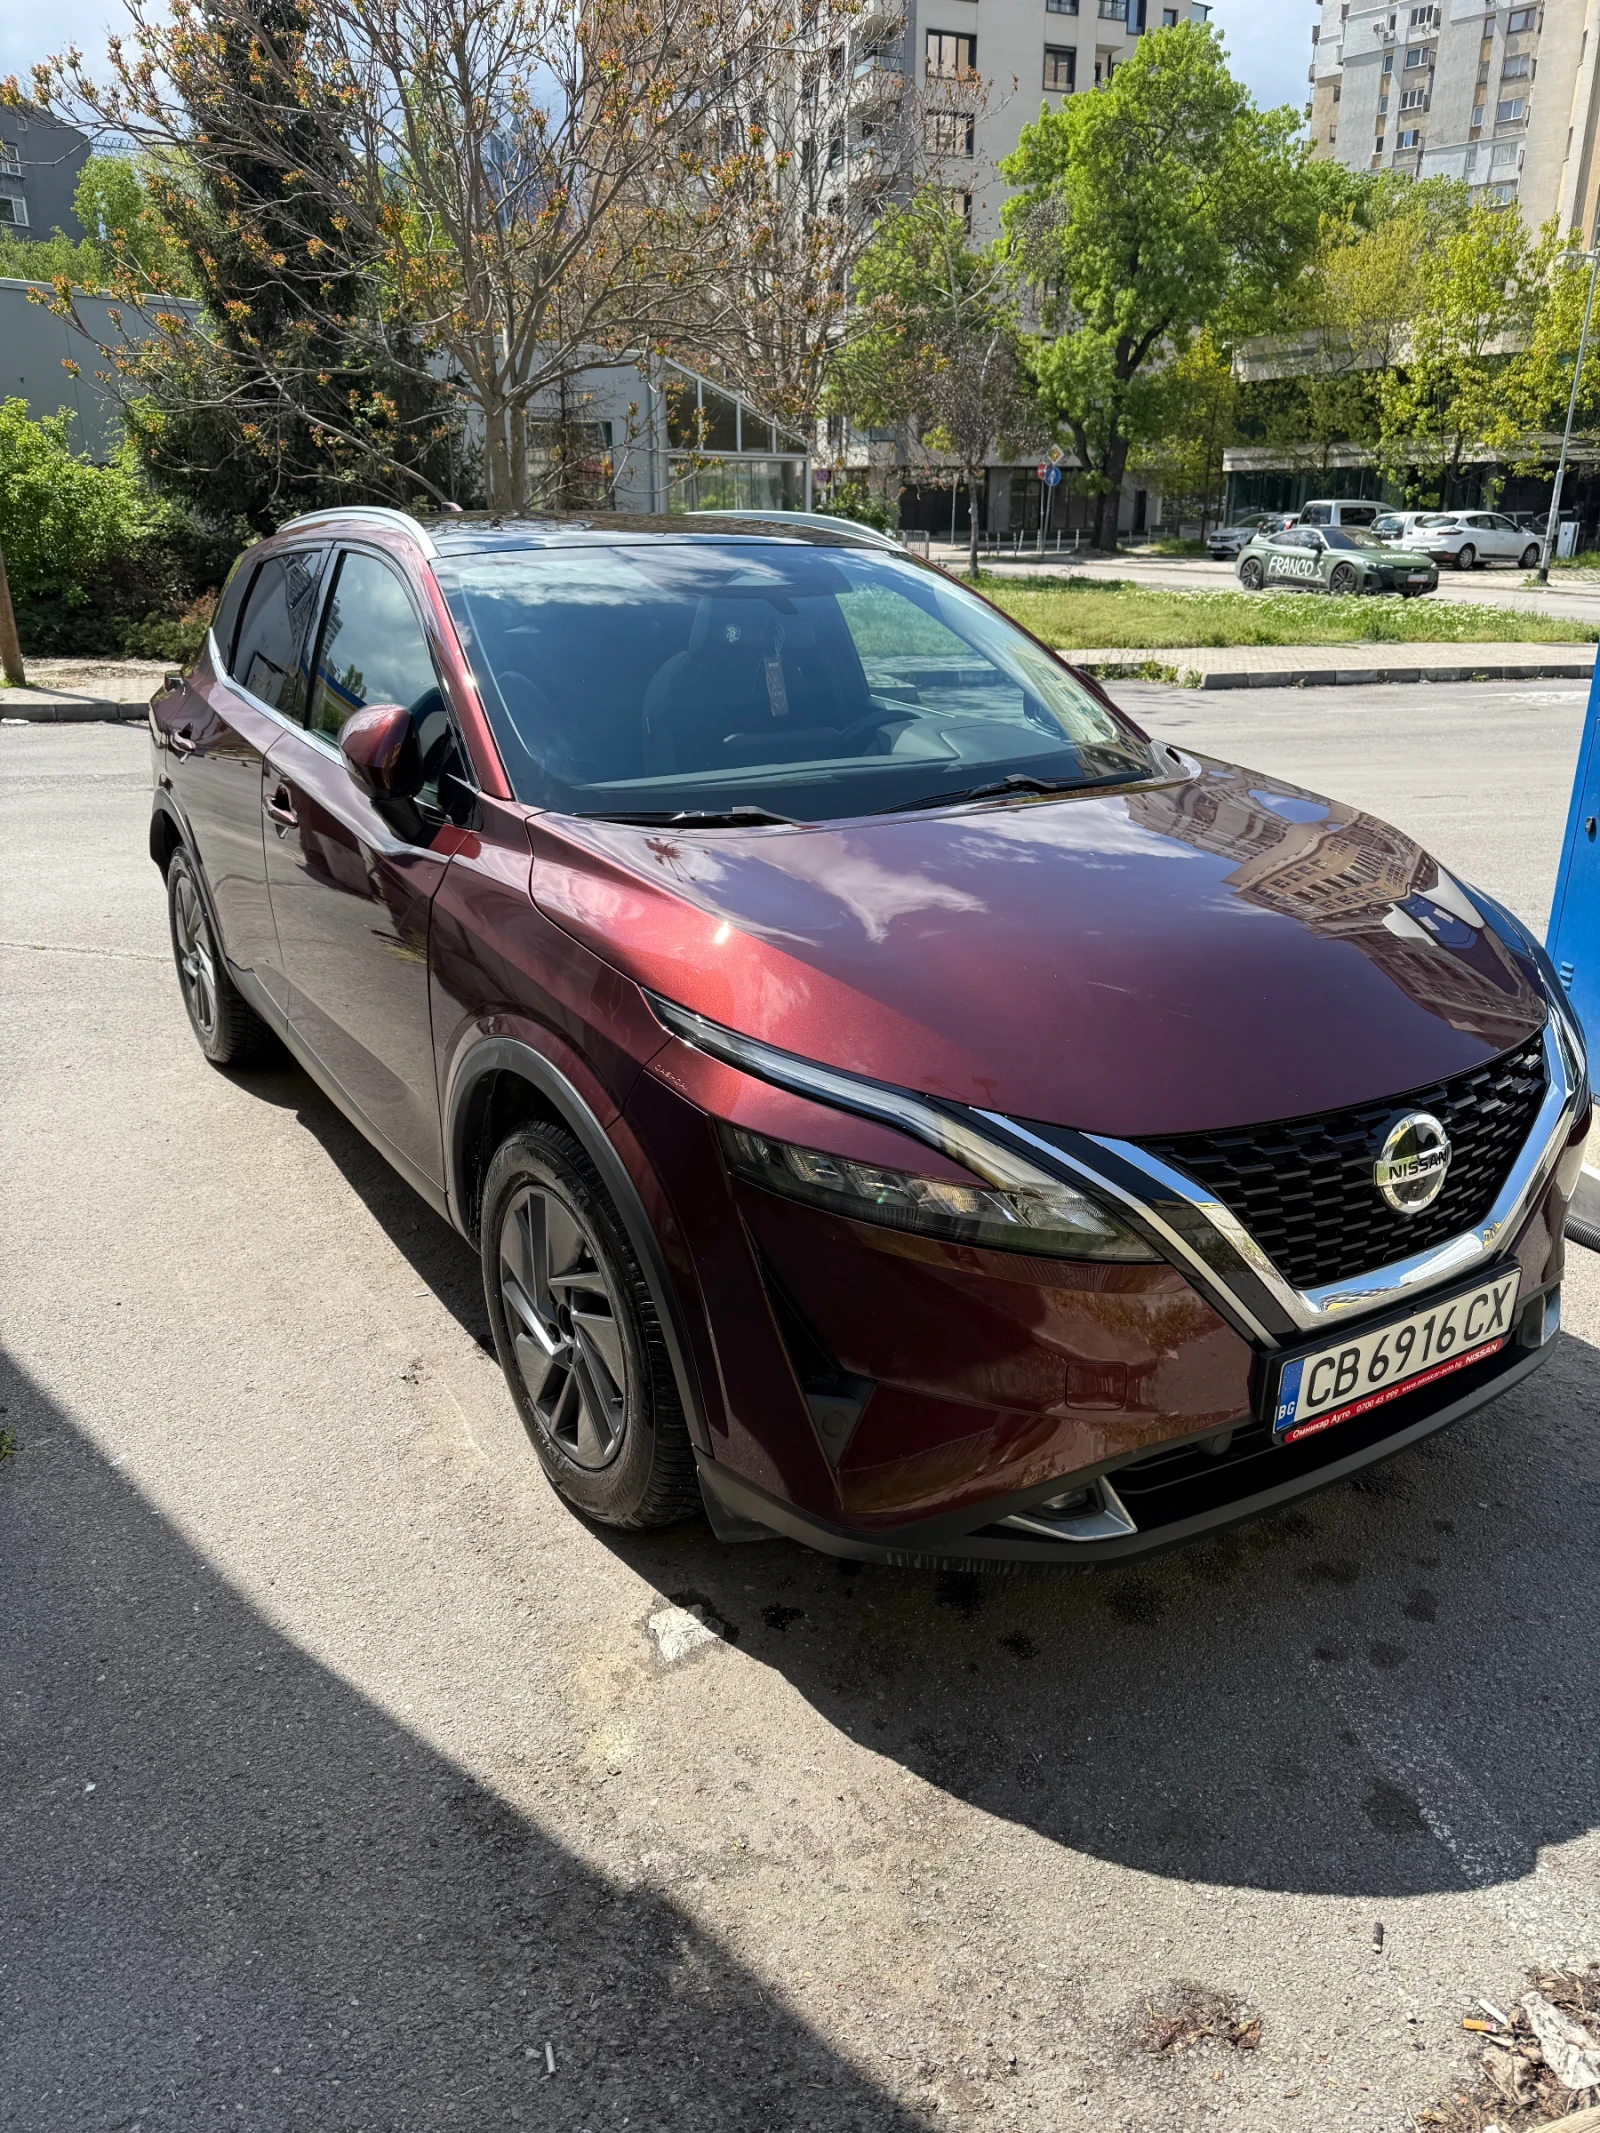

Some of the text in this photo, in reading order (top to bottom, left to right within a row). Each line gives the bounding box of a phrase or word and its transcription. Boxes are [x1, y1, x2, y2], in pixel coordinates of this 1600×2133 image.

[1268, 555, 1314, 577] FRANCO
[1389, 1150, 1448, 1180] NISSAN
[1277, 1281, 1513, 1421] BG CB 6916 CX
[1292, 1418, 1329, 1439] Омникар
[1331, 1410, 1351, 1424] Ауто
[1356, 1400, 1373, 1412] 0700
[1373, 1395, 1384, 1405] 45
[1385, 1388, 1399, 1400] 999
[1465, 1343, 1498, 1365] NISSAN
